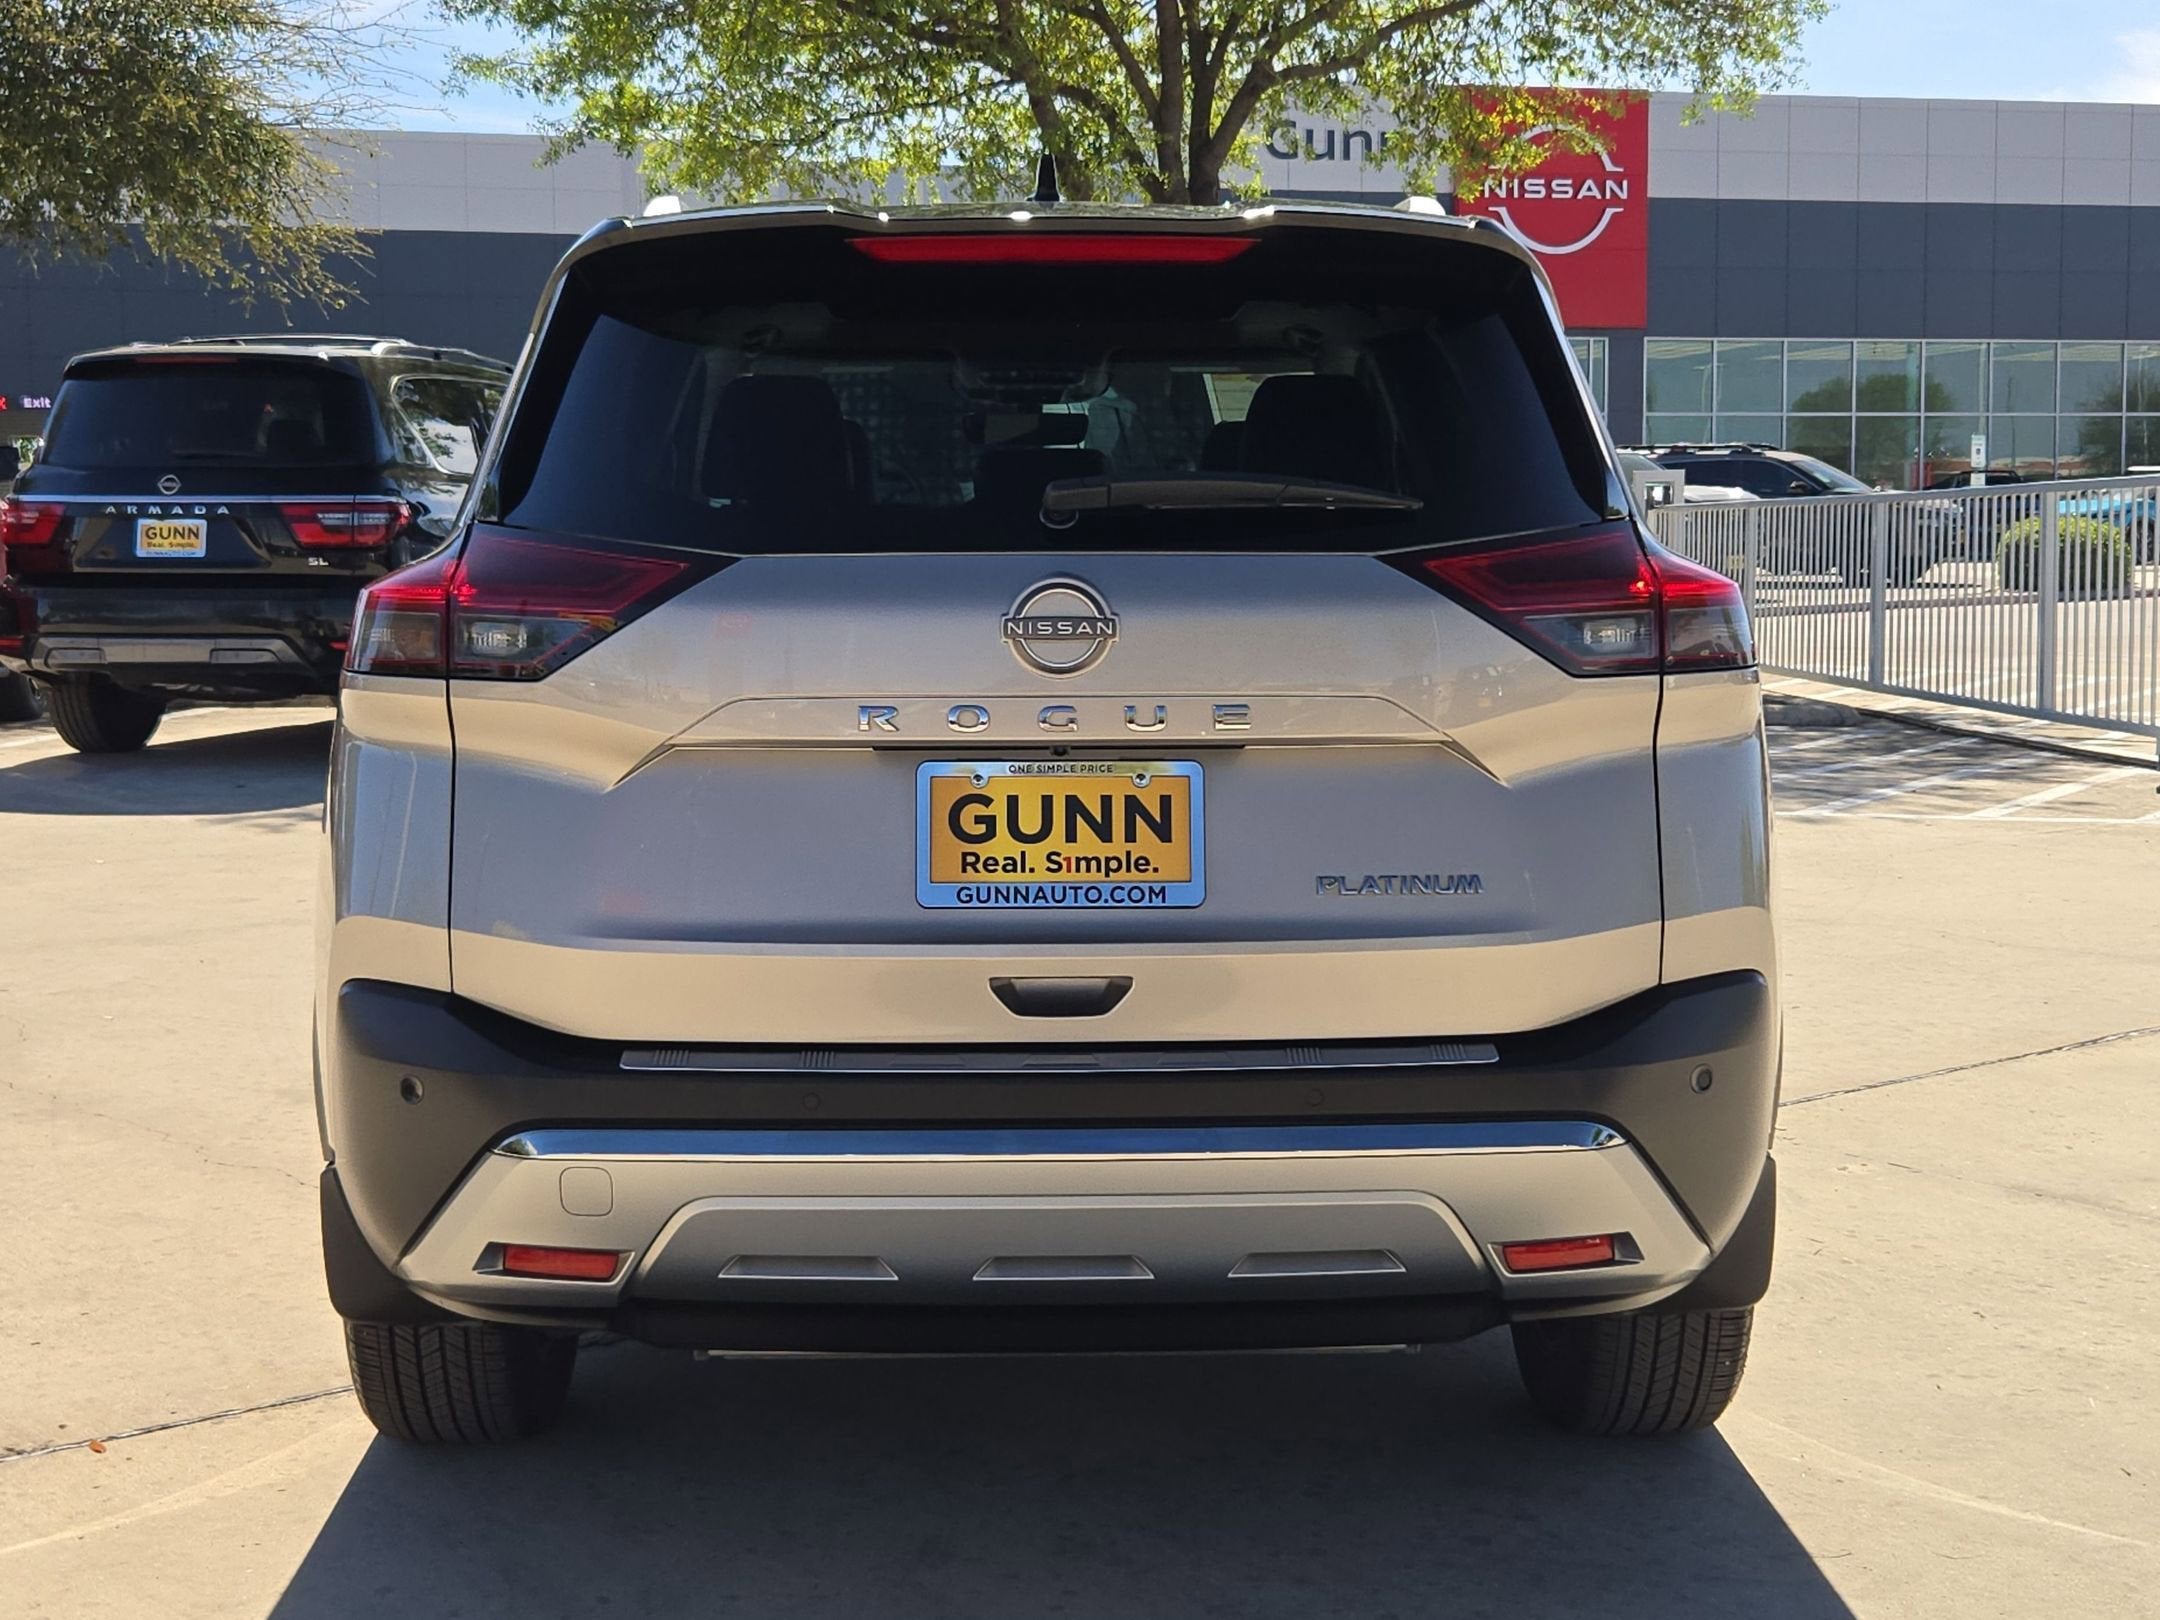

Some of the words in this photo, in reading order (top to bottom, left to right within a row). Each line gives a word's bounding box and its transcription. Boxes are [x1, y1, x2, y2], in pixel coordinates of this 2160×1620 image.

[1484, 177, 1628, 199] NISSAN
[22, 396, 51, 408] Exit
[105, 505, 230, 514] ARMADA
[145, 526, 200, 540] GUNN
[308, 557, 329, 566] SL
[1007, 620, 1113, 636] NISSAN
[858, 704, 1252, 733] ROGUE
[1008, 764, 1033, 774] ONE
[1036, 764, 1077, 774] SIMPLE
[1080, 764, 1113, 774] PRICE
[948, 793, 1173, 845] GUNN
[961, 851, 1036, 874] Real.
[1315, 874, 1484, 896] PLATINUM
[956, 886, 1167, 905] GUNNAUTO.COM
